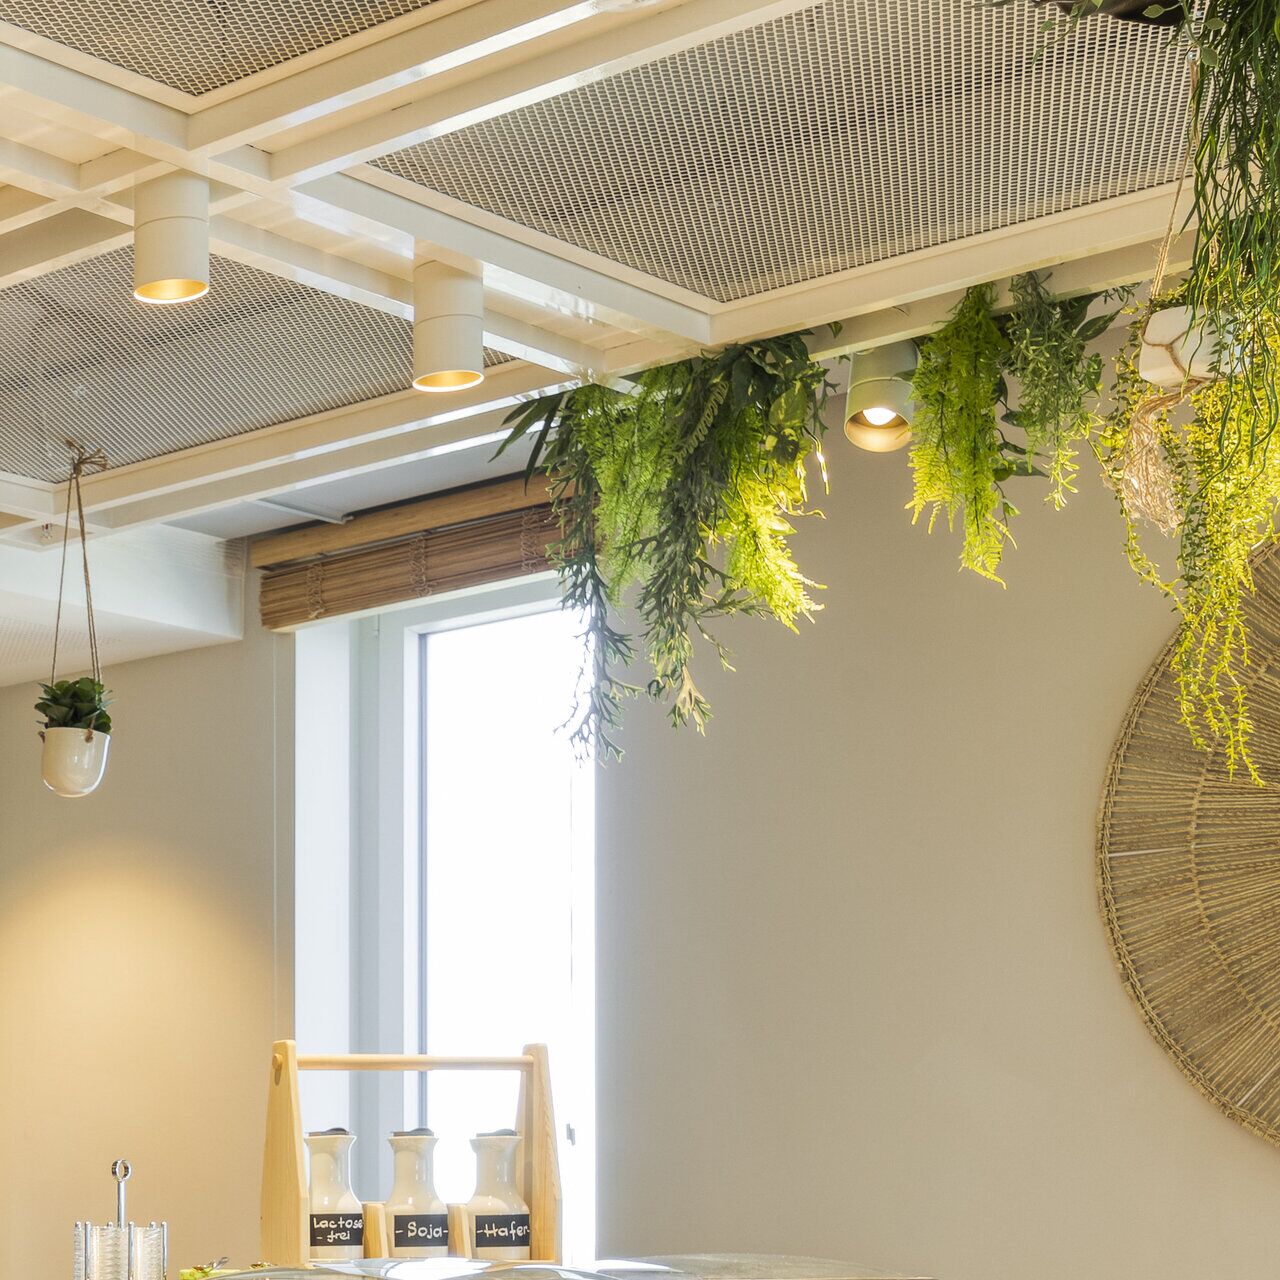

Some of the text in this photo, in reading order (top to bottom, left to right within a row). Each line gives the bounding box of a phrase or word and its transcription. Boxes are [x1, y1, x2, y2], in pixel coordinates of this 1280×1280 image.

[313, 1217, 363, 1229] Lactose
[327, 1231, 350, 1243] frei
[407, 1222, 442, 1239] Soja
[483, 1221, 528, 1240] Hafer
